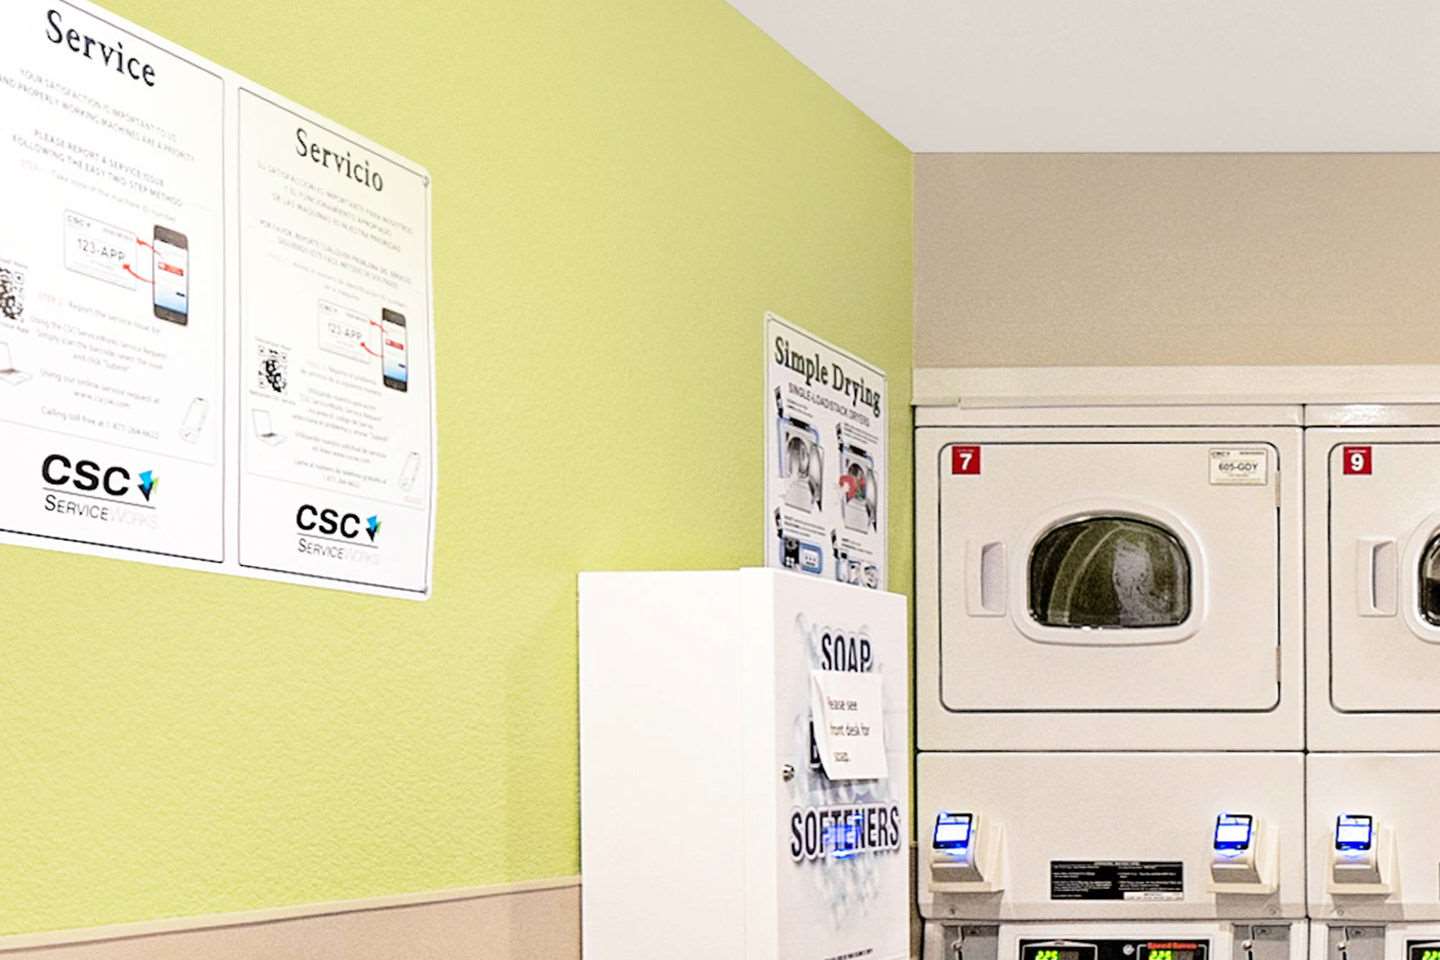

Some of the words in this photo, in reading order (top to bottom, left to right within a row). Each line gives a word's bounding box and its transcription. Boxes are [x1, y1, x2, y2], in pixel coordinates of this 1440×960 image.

[45, 9, 155, 87] Service
[296, 128, 384, 192] Servicio
[775, 336, 828, 386] Simple
[832, 363, 881, 418] Drying
[42, 454, 130, 496] CSC
[959, 453, 972, 471] 7
[1350, 453, 1365, 471] 9
[296, 504, 361, 539] CSC
[821, 632, 871, 672] SOAP
[791, 806, 899, 857] SOFTENERS
